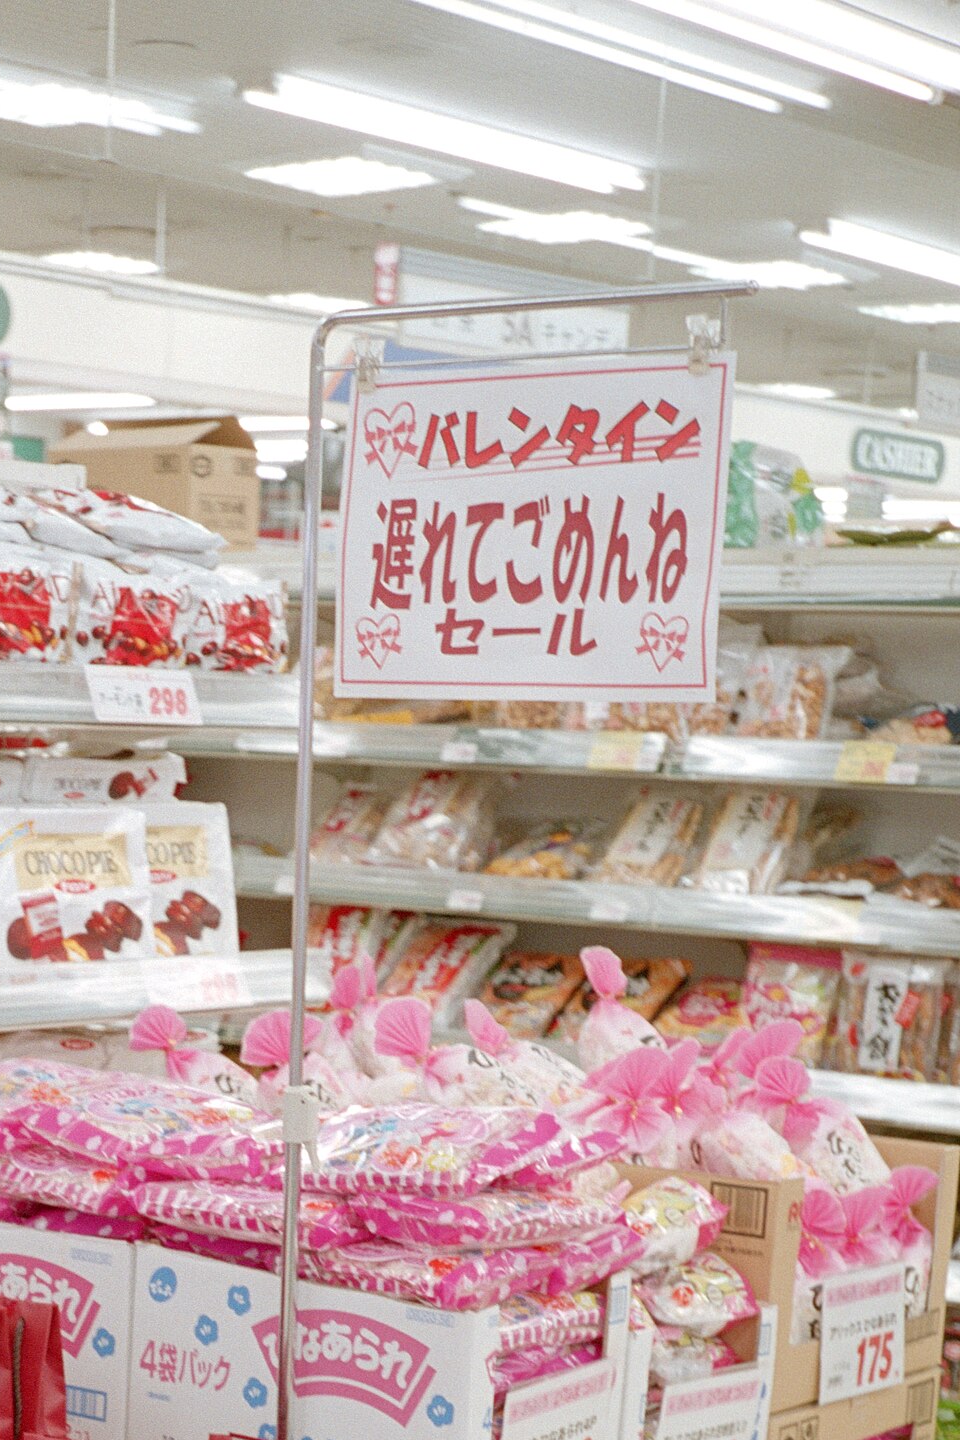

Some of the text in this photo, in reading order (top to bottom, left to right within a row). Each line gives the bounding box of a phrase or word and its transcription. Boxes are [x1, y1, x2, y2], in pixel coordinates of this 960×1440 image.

[418, 398, 701, 470] バレンタイン
[370, 492, 688, 610] 遅れてごめんね
[434, 607, 598, 656] セール
[149, 687, 189, 716] 298
[139, 1338, 232, 1392] 4袋パック
[856, 1331, 895, 1387] 175
